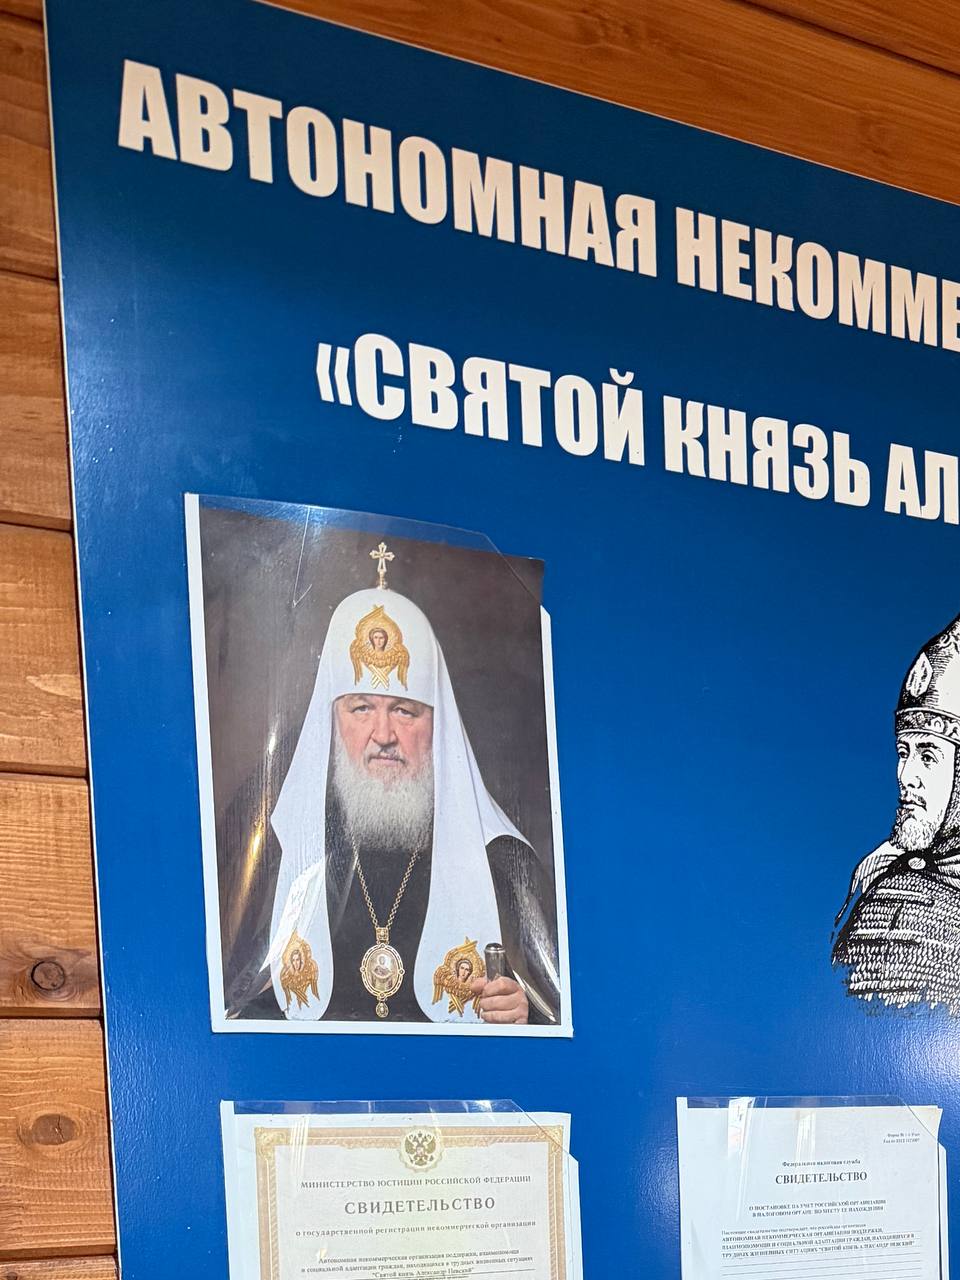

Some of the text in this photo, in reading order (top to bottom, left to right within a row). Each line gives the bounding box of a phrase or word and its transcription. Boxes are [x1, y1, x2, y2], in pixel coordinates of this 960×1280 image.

[118, 59, 657, 278] АВТОНОМНАЯ
[315, 332, 646, 466] «СВЯТОЙ
[663, 395, 871, 507] КНЯЗЬ
[300, 1176, 531, 1189] МИНИСТЕРСТВО ЮСТИЦИИ РОССИЙСКОЙ ФЕДЕРАЦИИ
[775, 1170, 868, 1185] СВИДЕТЕЛЬСТВО
[344, 1197, 495, 1216] СВИДЕТЕЛЬСТВО
[303, 1227, 374, 1238] государственной
[375, 1224, 425, 1235] регистрации
[427, 1221, 489, 1233] некоммерческой
[490, 1221, 536, 1230] организации
